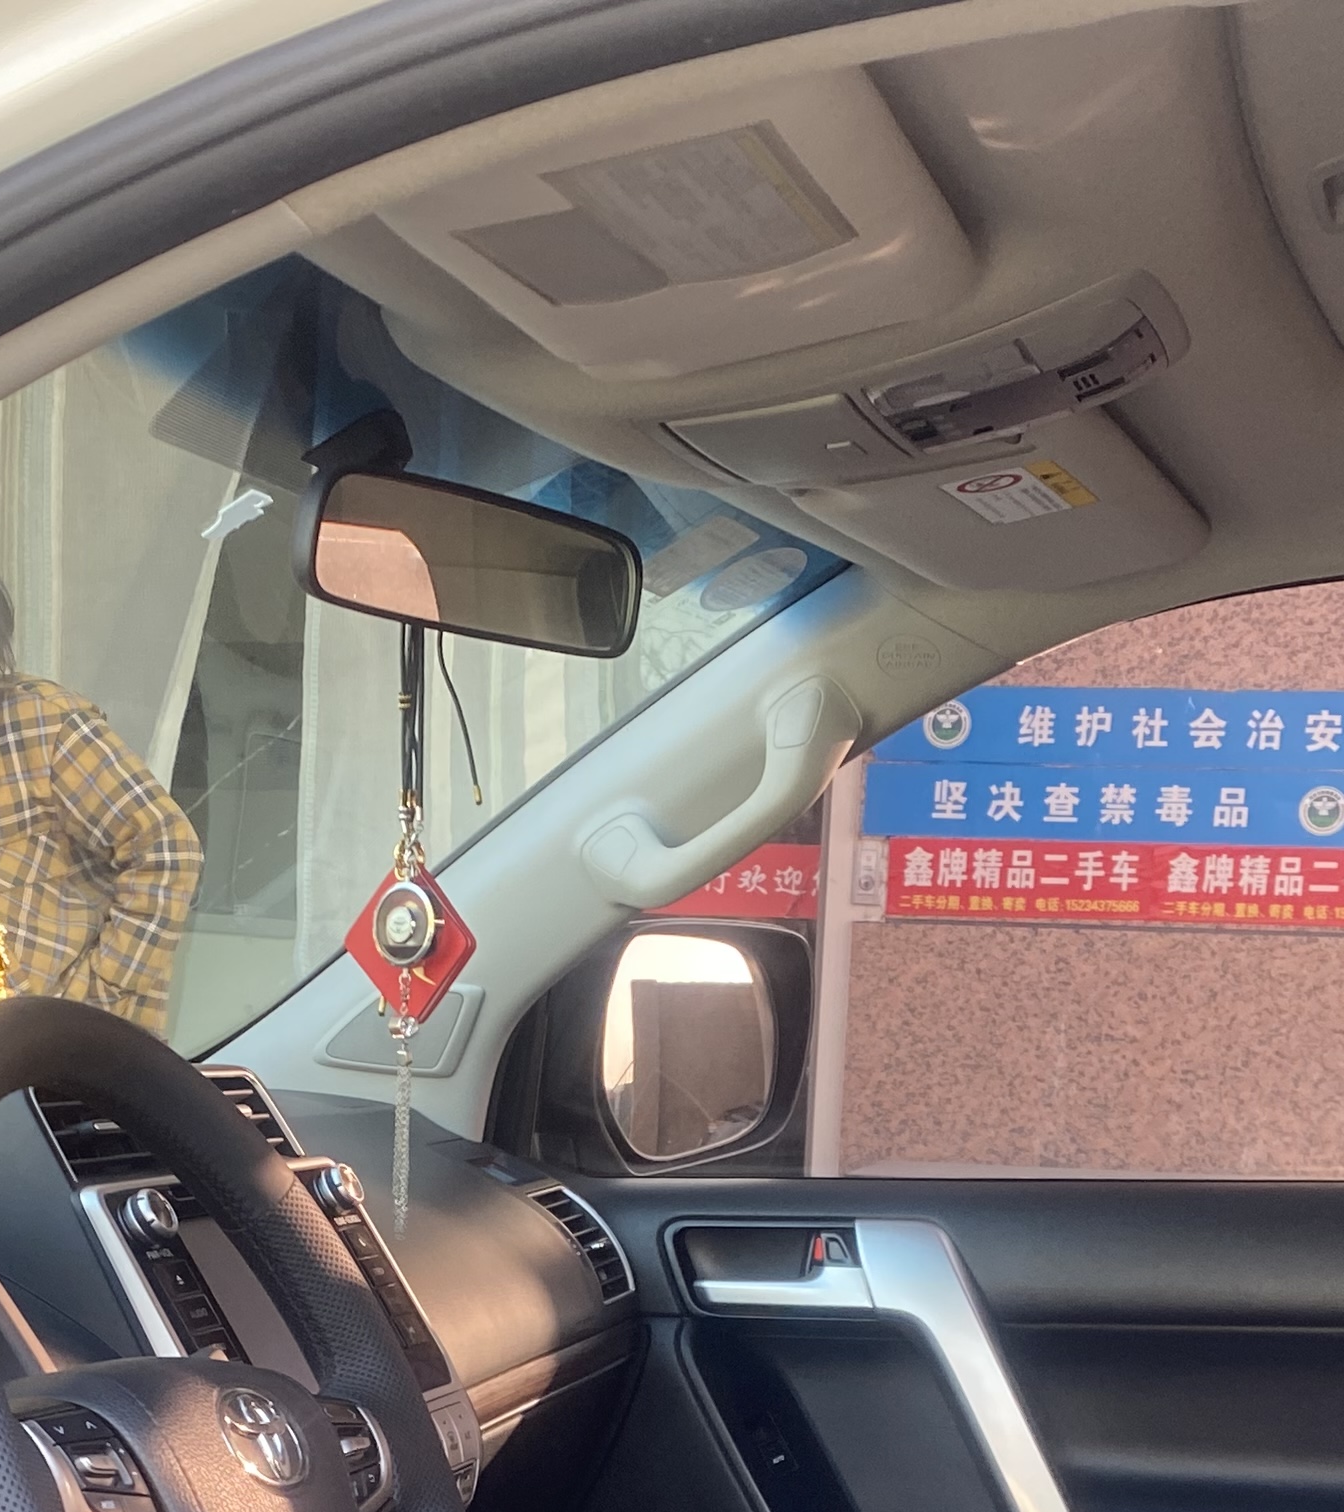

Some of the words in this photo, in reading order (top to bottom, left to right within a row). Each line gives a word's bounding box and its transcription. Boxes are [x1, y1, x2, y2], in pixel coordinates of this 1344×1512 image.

[1018, 704, 1343, 752] 维护社会治安
[931, 779, 1249, 828] 坚决查禁毒品
[903, 846, 1140, 892] 鑫牌精品二手车
